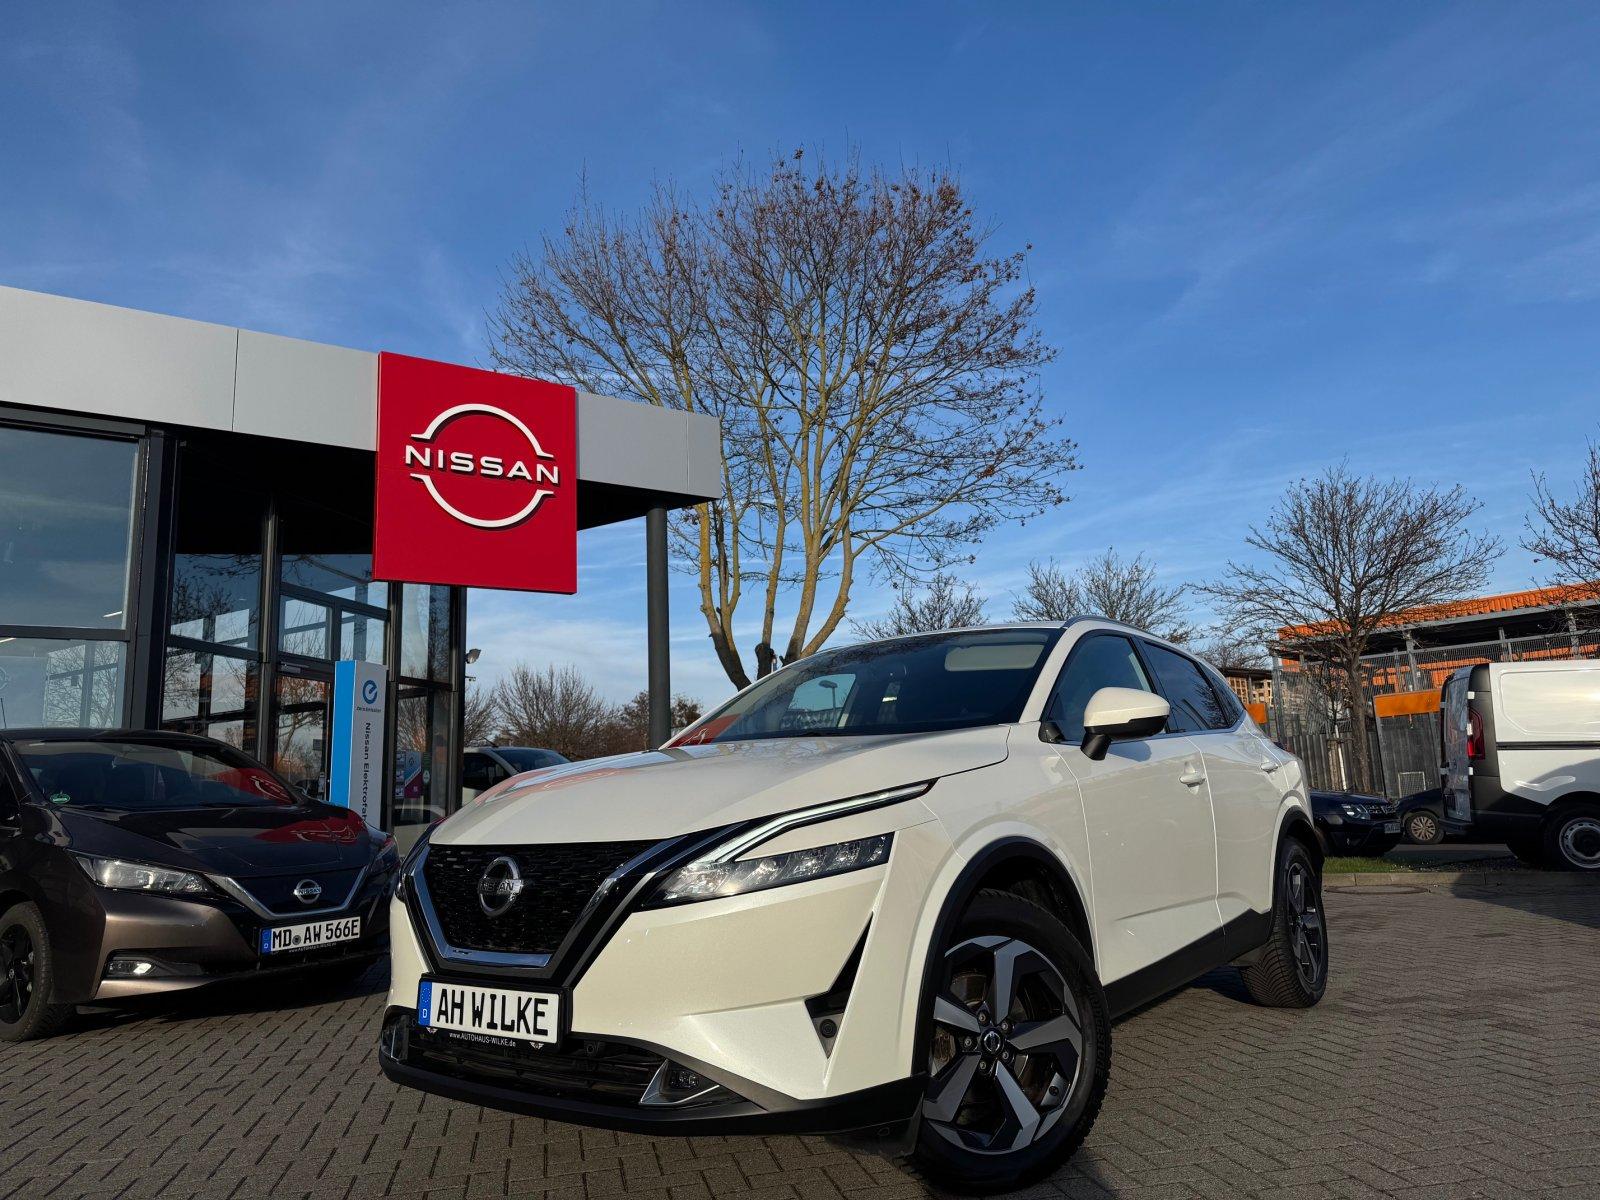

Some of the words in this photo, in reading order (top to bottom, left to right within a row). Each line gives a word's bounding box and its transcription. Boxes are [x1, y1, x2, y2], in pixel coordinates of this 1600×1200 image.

[405, 445, 560, 485] NISSAN
[363, 722, 372, 760] Nissan
[272, 929, 292, 949] MD
[304, 924, 322, 944] AW
[325, 919, 359, 940] 566E
[422, 1008, 428, 1019] D
[436, 988, 465, 1025] AH
[471, 991, 549, 1037] WILKE
[449, 1032, 516, 1047] www.AUTOHAUS-WILKE.de
